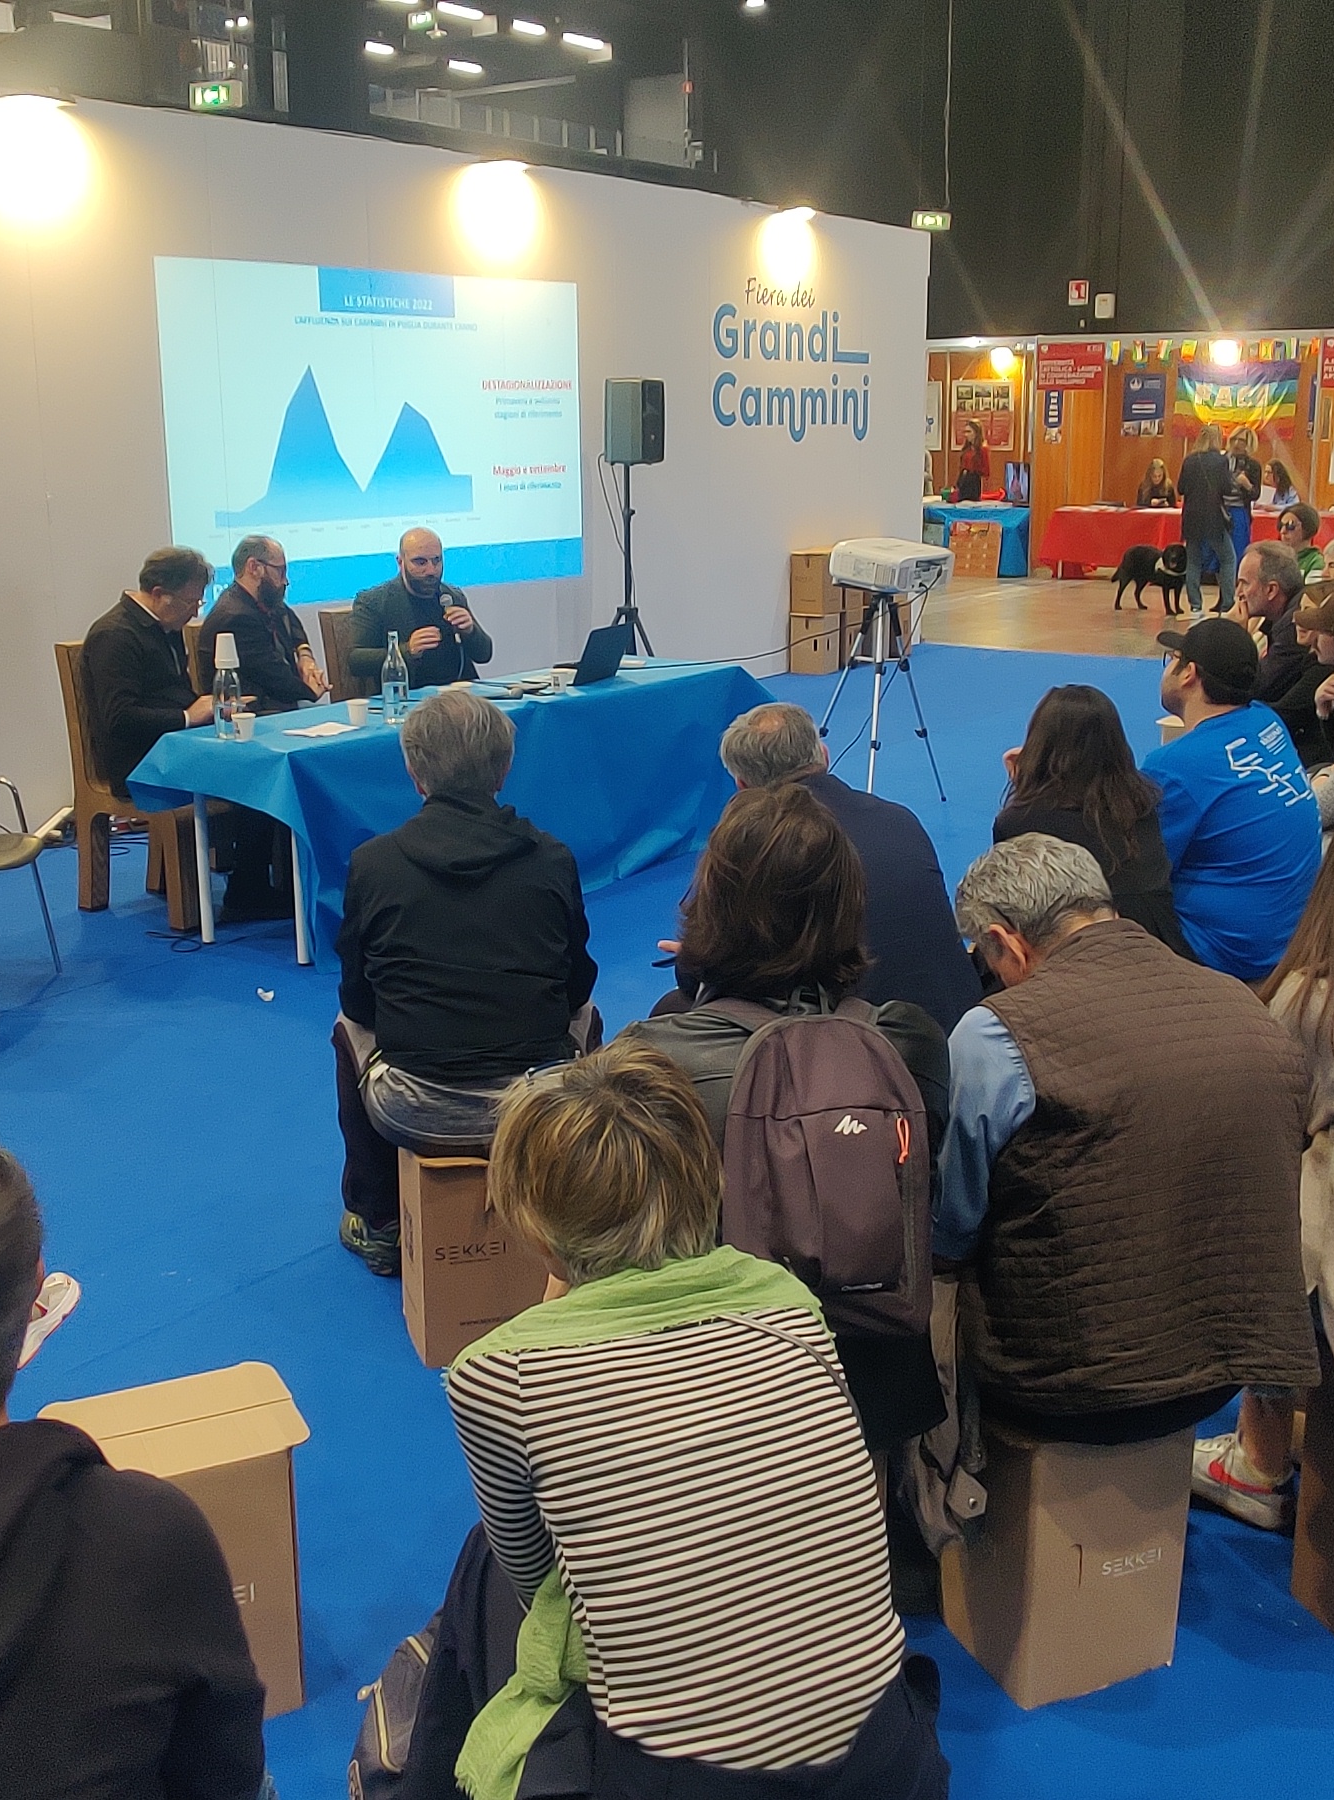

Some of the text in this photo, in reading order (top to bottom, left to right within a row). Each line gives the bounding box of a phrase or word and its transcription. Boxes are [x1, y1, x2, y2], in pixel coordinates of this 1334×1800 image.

[344, 295, 433, 311] LE STATISTICHE 2022
[744, 277, 816, 309] Fiera dei
[713, 303, 870, 364] Grandi
[712, 371, 870, 443] Cammini
[435, 1241, 506, 1261] SEKKEI
[1101, 1546, 1162, 1576] SEKKEI
